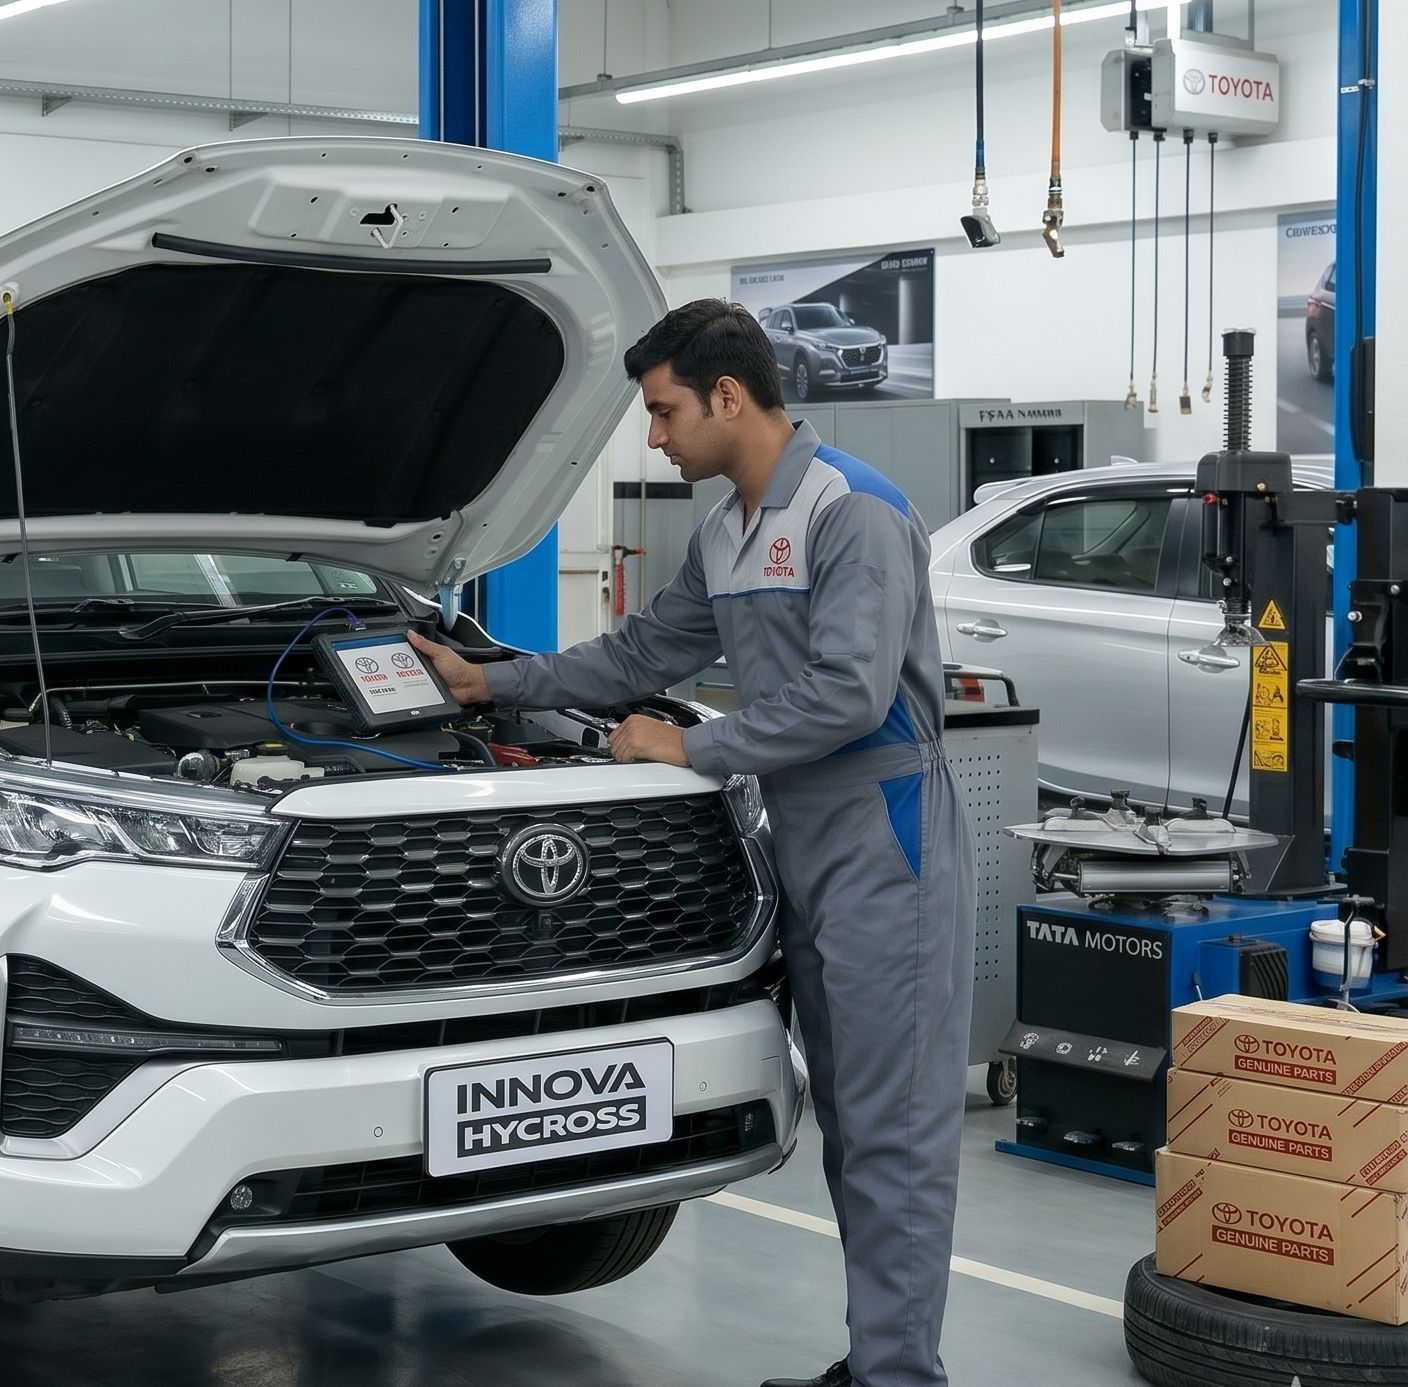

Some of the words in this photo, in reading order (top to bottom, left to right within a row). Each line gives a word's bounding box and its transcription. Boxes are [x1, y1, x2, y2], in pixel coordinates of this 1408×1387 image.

[1209, 74, 1274, 102] TOYOTA
[1026, 920, 1079, 947] TATA
[1085, 930, 1163, 960] MOTORS
[1262, 1040, 1337, 1066] TOYOTA
[1238, 1058, 1291, 1076] GENUINE
[1294, 1067, 1334, 1083] PARTS
[457, 1062, 646, 1115] INNOVA
[464, 1103, 641, 1150] HYCROSS
[1257, 1114, 1333, 1141] TOYOTA
[1231, 1132, 1285, 1151] GENUINE
[1289, 1144, 1330, 1159] PARTS
[1245, 1209, 1334, 1242] TOYOTA
[1216, 1229, 1278, 1252] GENUINE
[1282, 1243, 1329, 1262] PARTS
